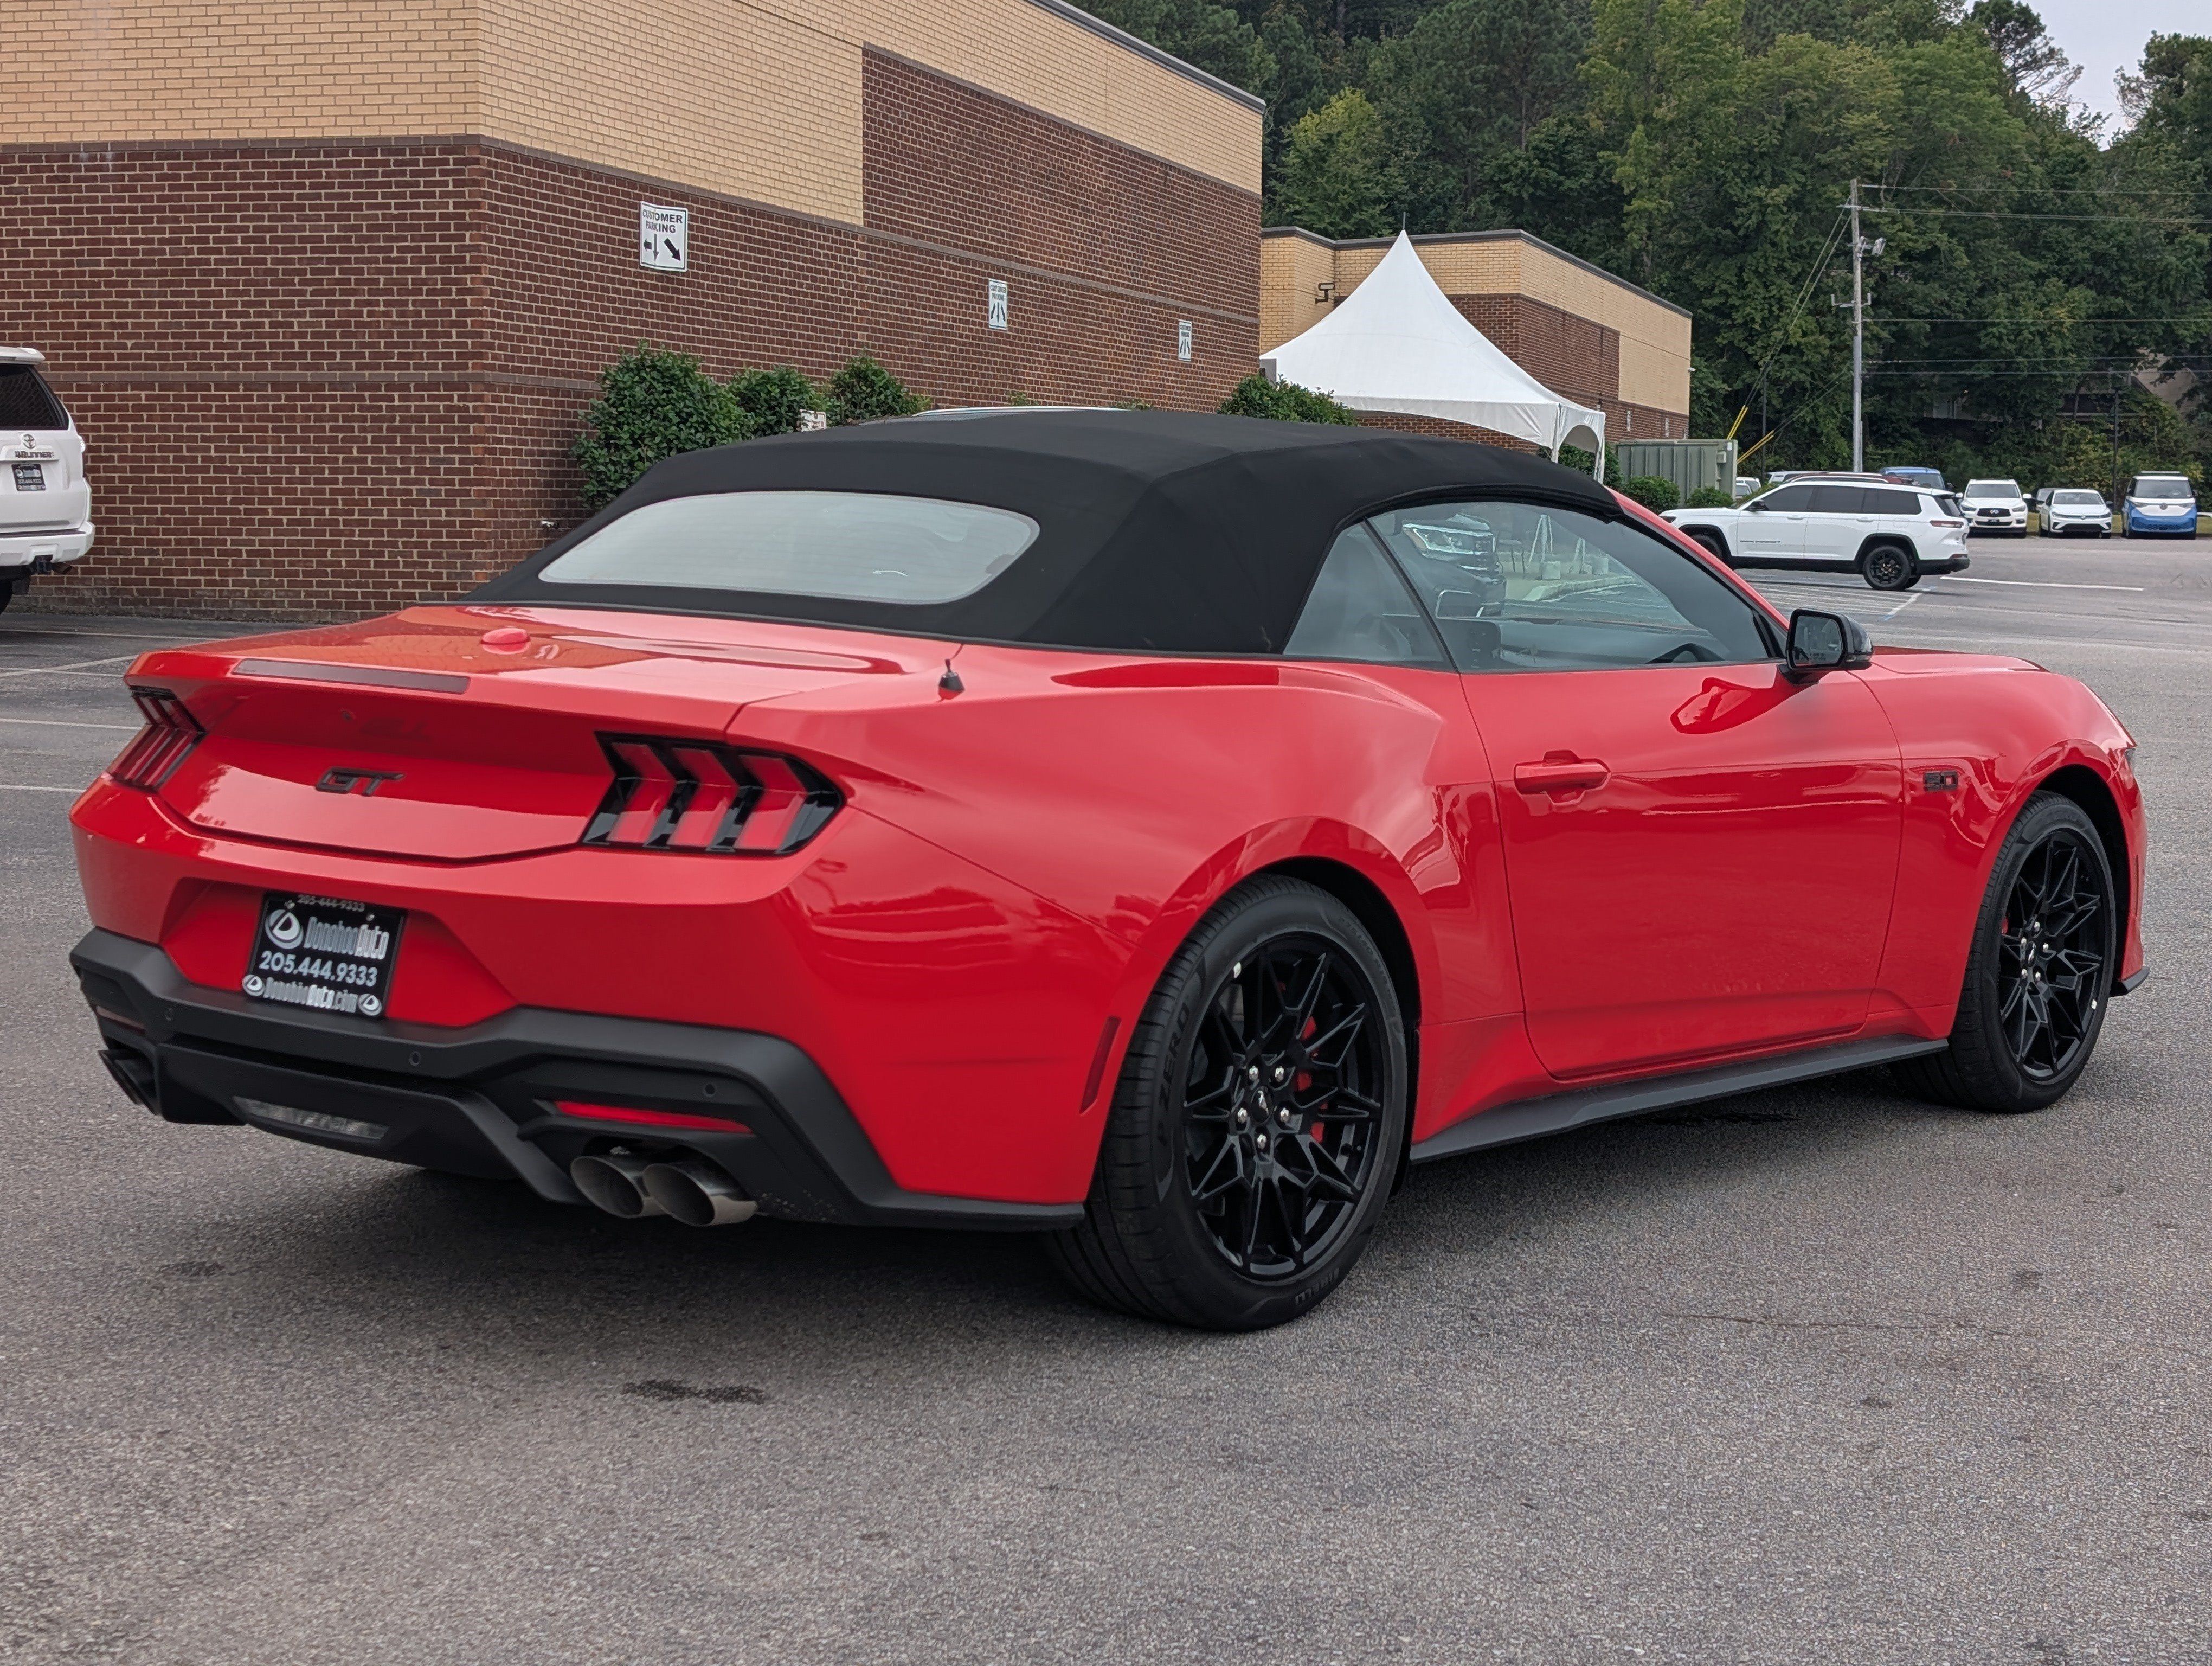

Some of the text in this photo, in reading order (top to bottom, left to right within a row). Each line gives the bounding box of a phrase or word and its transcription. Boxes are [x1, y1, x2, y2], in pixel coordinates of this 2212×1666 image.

[642, 209, 683, 223] CUSTOMER
[645, 220, 676, 233] PARKING
[316, 766, 406, 797] GT
[259, 950, 378, 987] 205.444.9333
